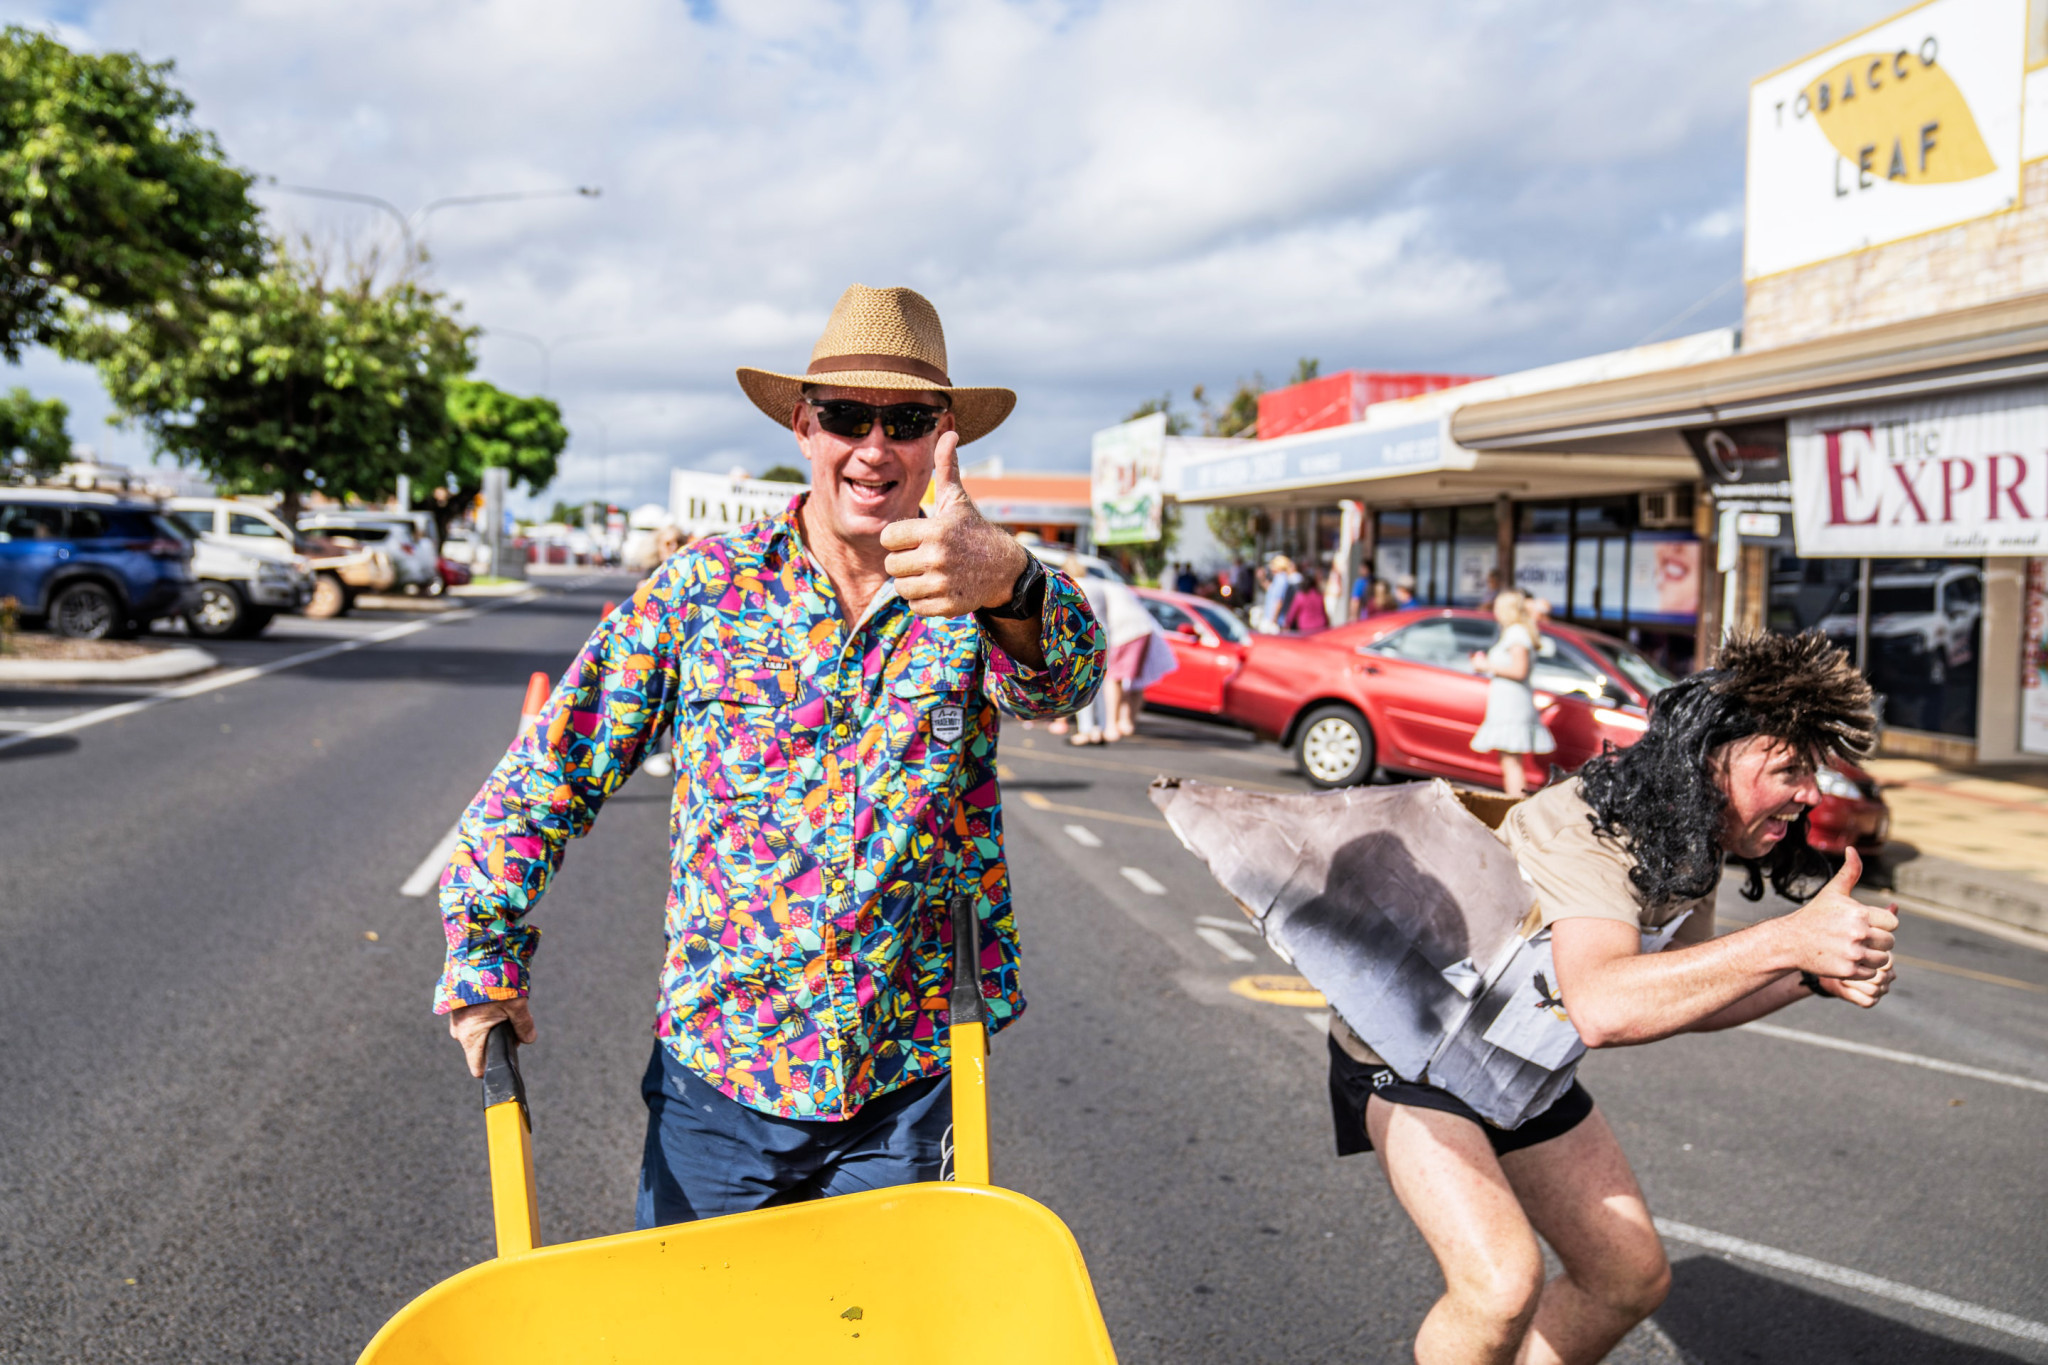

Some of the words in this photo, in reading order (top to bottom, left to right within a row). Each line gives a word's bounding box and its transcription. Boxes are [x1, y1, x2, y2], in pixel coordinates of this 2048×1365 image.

[1774, 36, 1939, 128] TOBACCO
[1835, 121, 1940, 198] LEAF
[1817, 421, 2048, 528] EXPR
[1879, 418, 1940, 459] The
